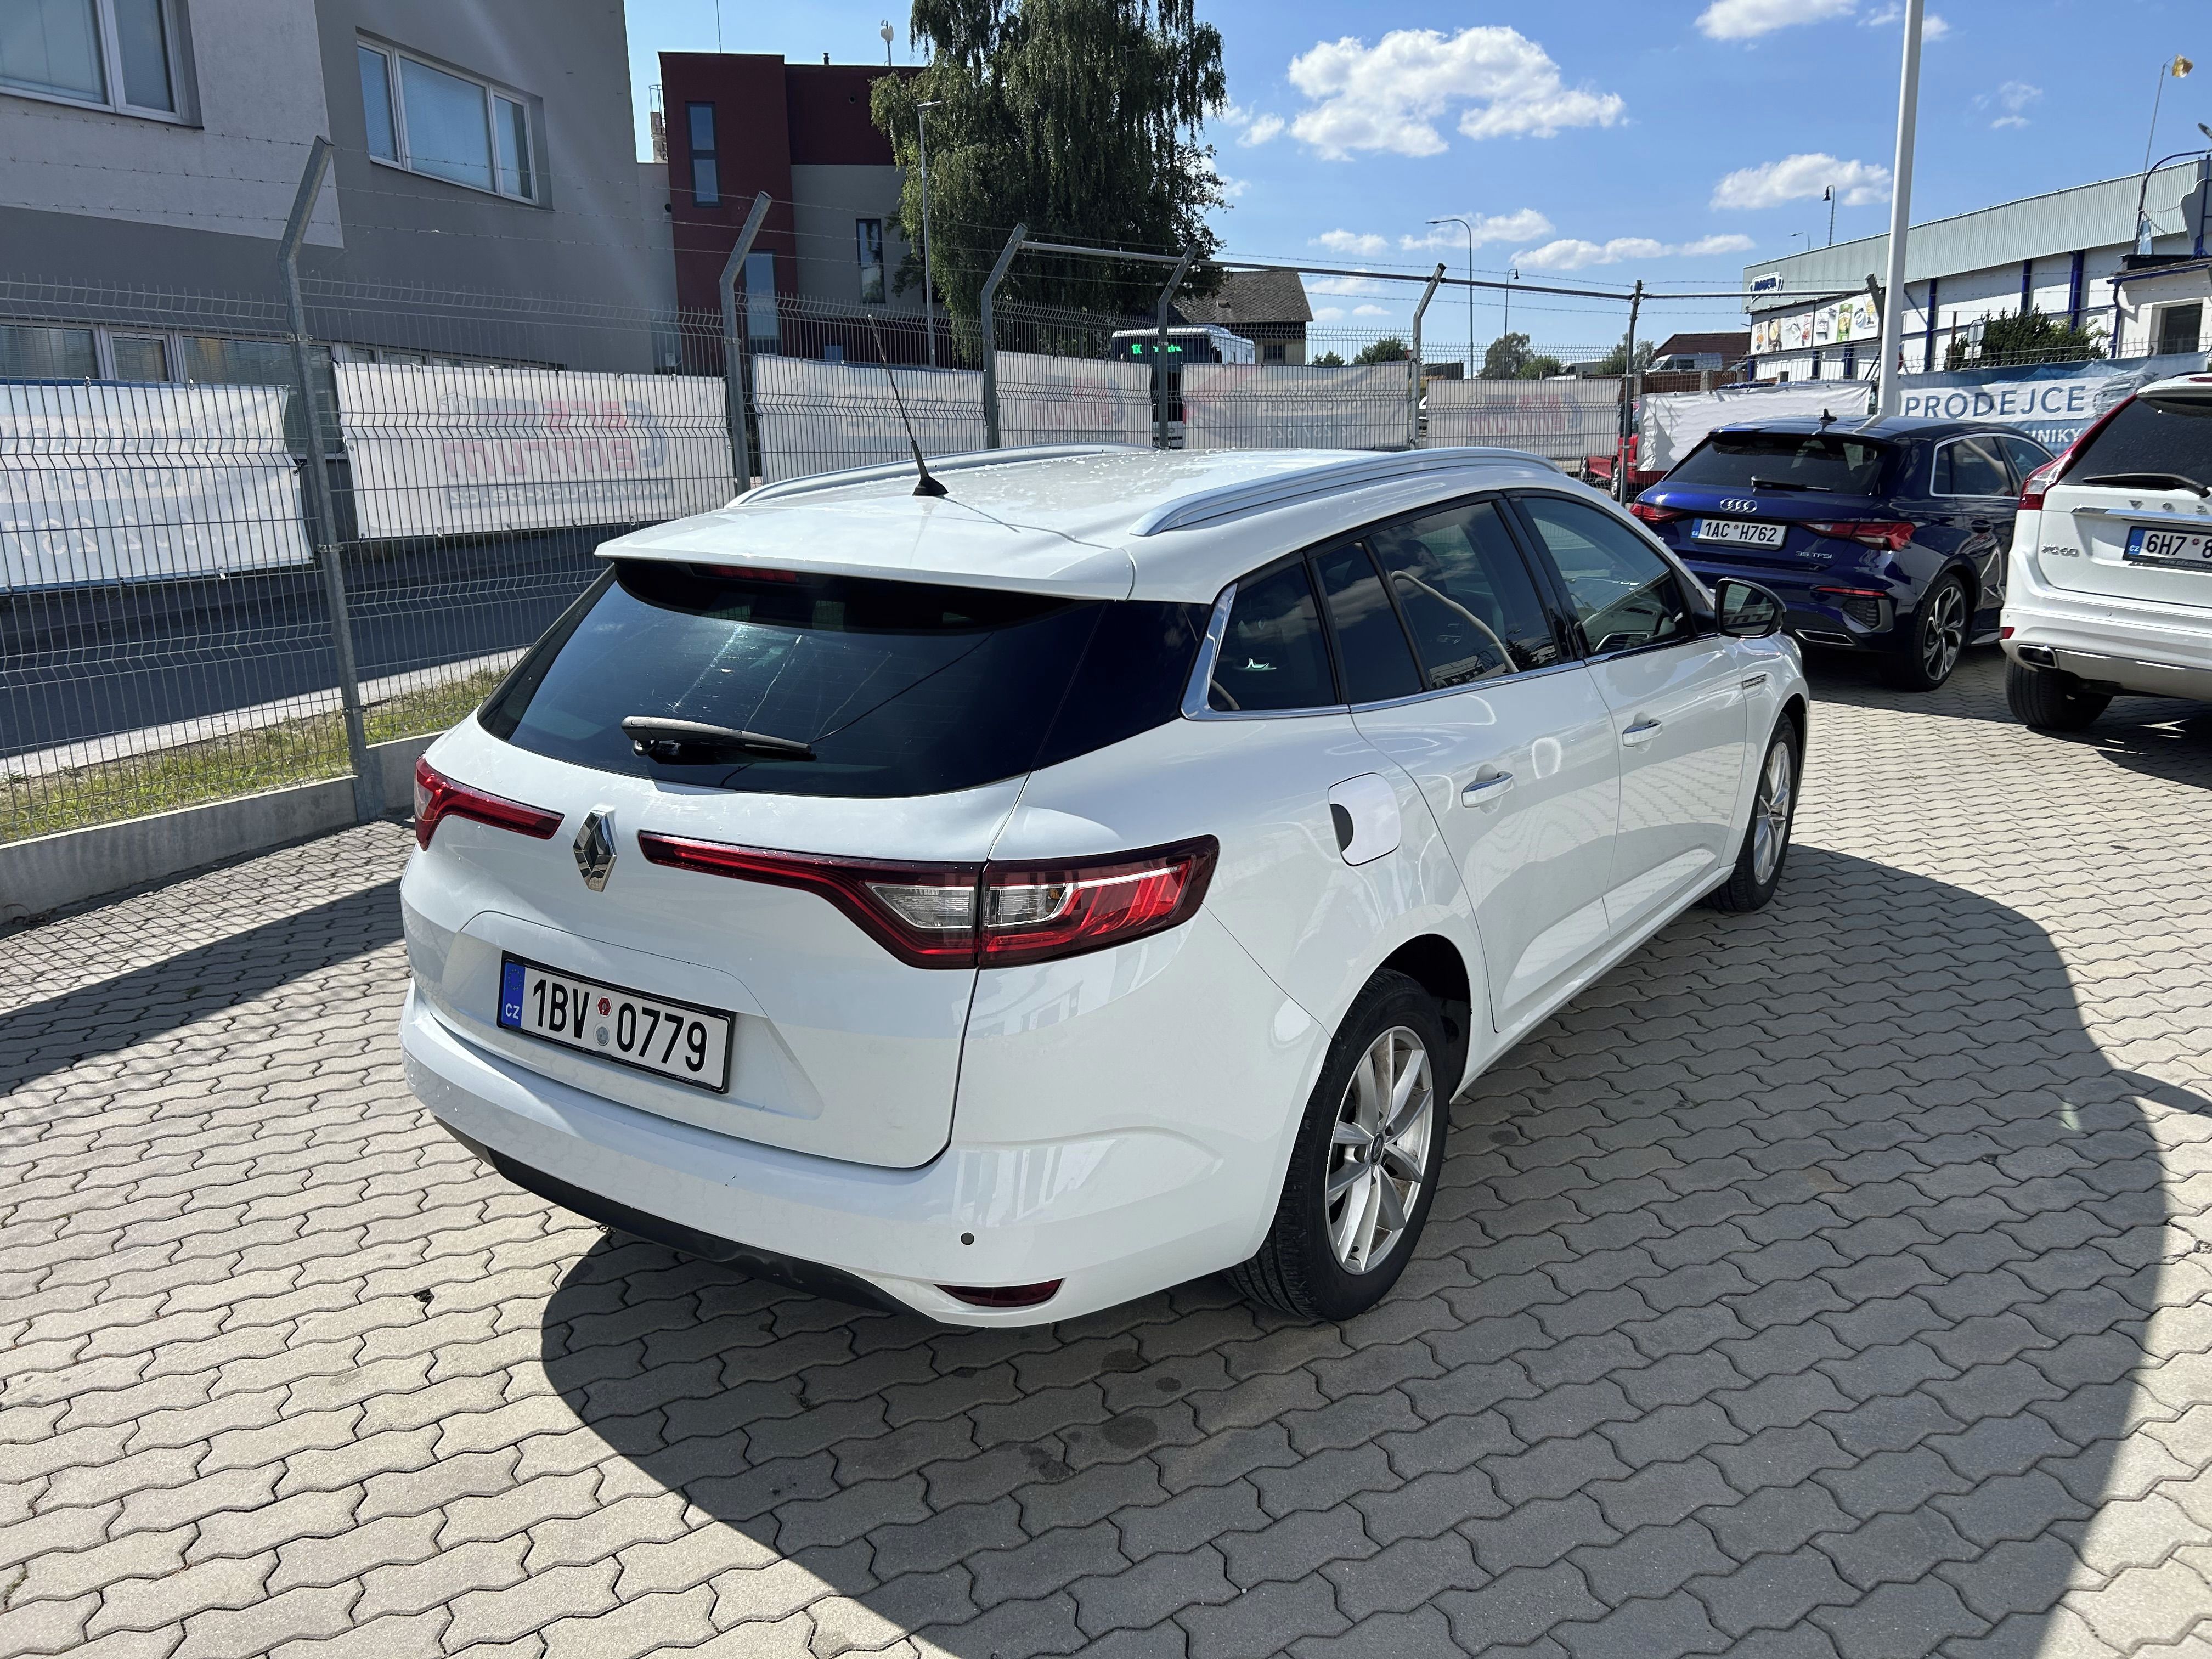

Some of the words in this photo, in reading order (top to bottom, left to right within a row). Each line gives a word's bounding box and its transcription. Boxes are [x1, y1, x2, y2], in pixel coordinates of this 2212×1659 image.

[1905, 386, 2086, 419] PRODEJCE
[1705, 522, 1730, 538] 1AC
[1739, 525, 1778, 543] H762
[2146, 533, 2187, 556] 6H7
[505, 1003, 520, 1020] CZ
[533, 979, 590, 1040] 1BV
[616, 1002, 708, 1073] 0779
